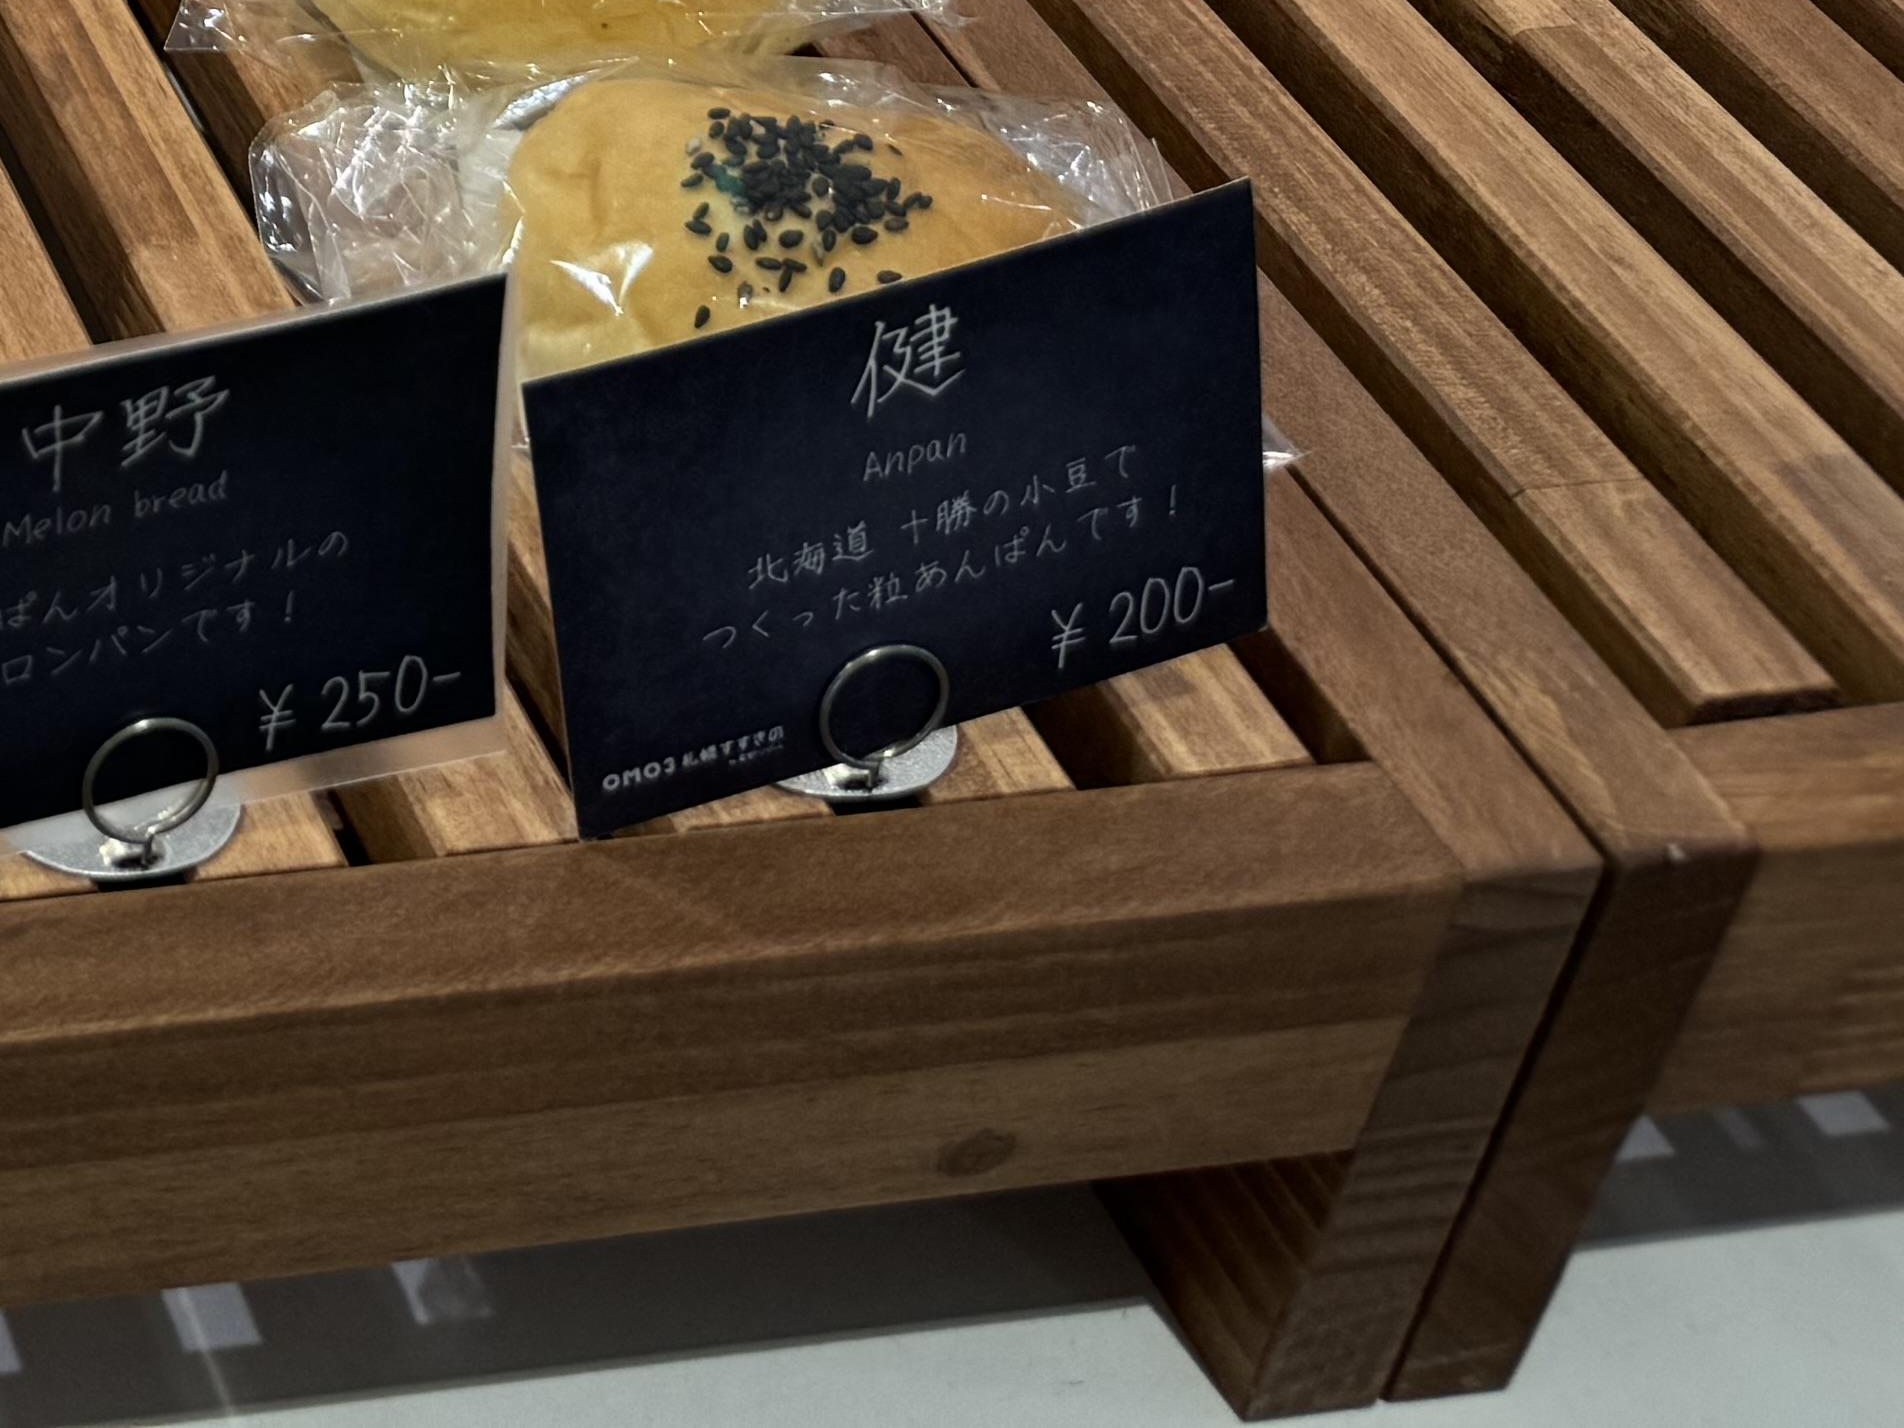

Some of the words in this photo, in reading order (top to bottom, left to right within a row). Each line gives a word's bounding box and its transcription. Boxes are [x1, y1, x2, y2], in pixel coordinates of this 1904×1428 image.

[851, 303, 966, 418] 健
[21, 374, 232, 493] 中野
[863, 432, 970, 484] Anpan
[1, 502, 112, 548] Melon
[134, 471, 230, 520] bread
[746, 519, 876, 592] 北海道
[900, 445, 1138, 546] 十勝の小豆で
[602, 757, 675, 790] OMO3
